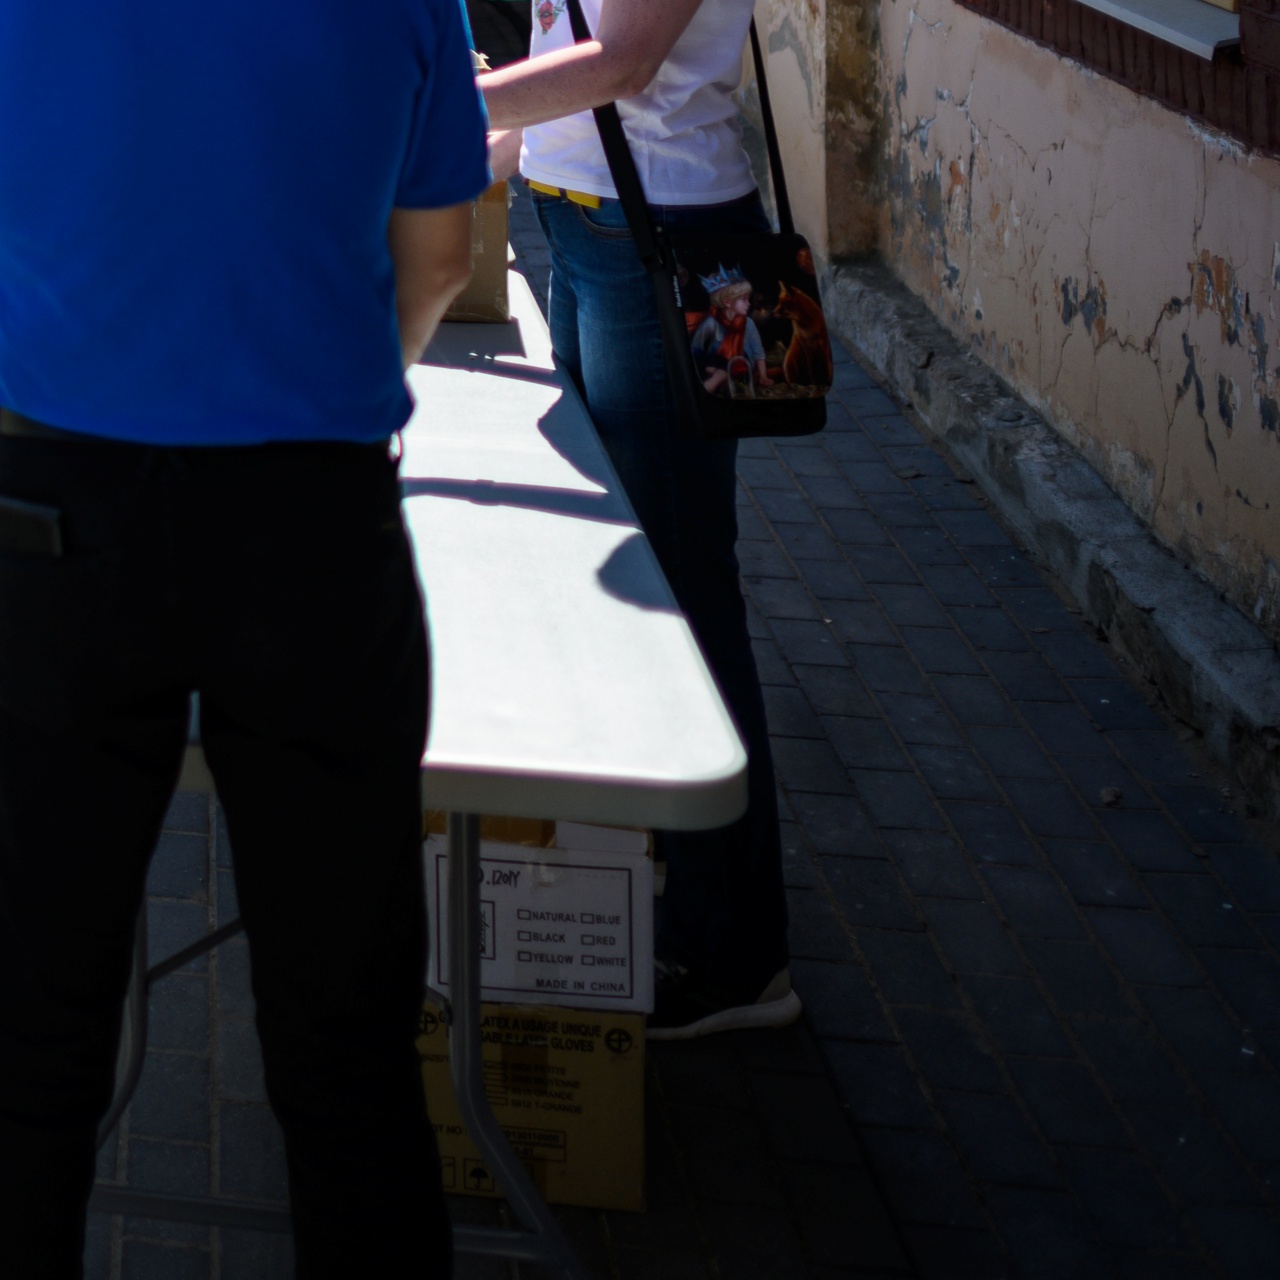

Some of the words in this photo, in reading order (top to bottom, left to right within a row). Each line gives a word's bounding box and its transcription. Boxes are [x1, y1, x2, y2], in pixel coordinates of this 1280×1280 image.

[532, 910, 577, 924] NATURAL
[595, 914, 621, 925] BLUE
[532, 931, 566, 943] BLACK
[595, 935, 616, 946] RED
[531, 952, 573, 964] YELLOW
[595, 956, 627, 967] WHITE
[536, 978, 568, 990] MADE
[573, 981, 585, 990] IN
[591, 981, 626, 993] CHINA
[522, 1019, 558, 1034] USAGE
[561, 1022, 602, 1038] UNIQUE
[551, 1037, 595, 1053] GLOVES
[534, 1087, 574, 1101] GRANDE
[534, 1099, 583, 1114] T-GRANDE
